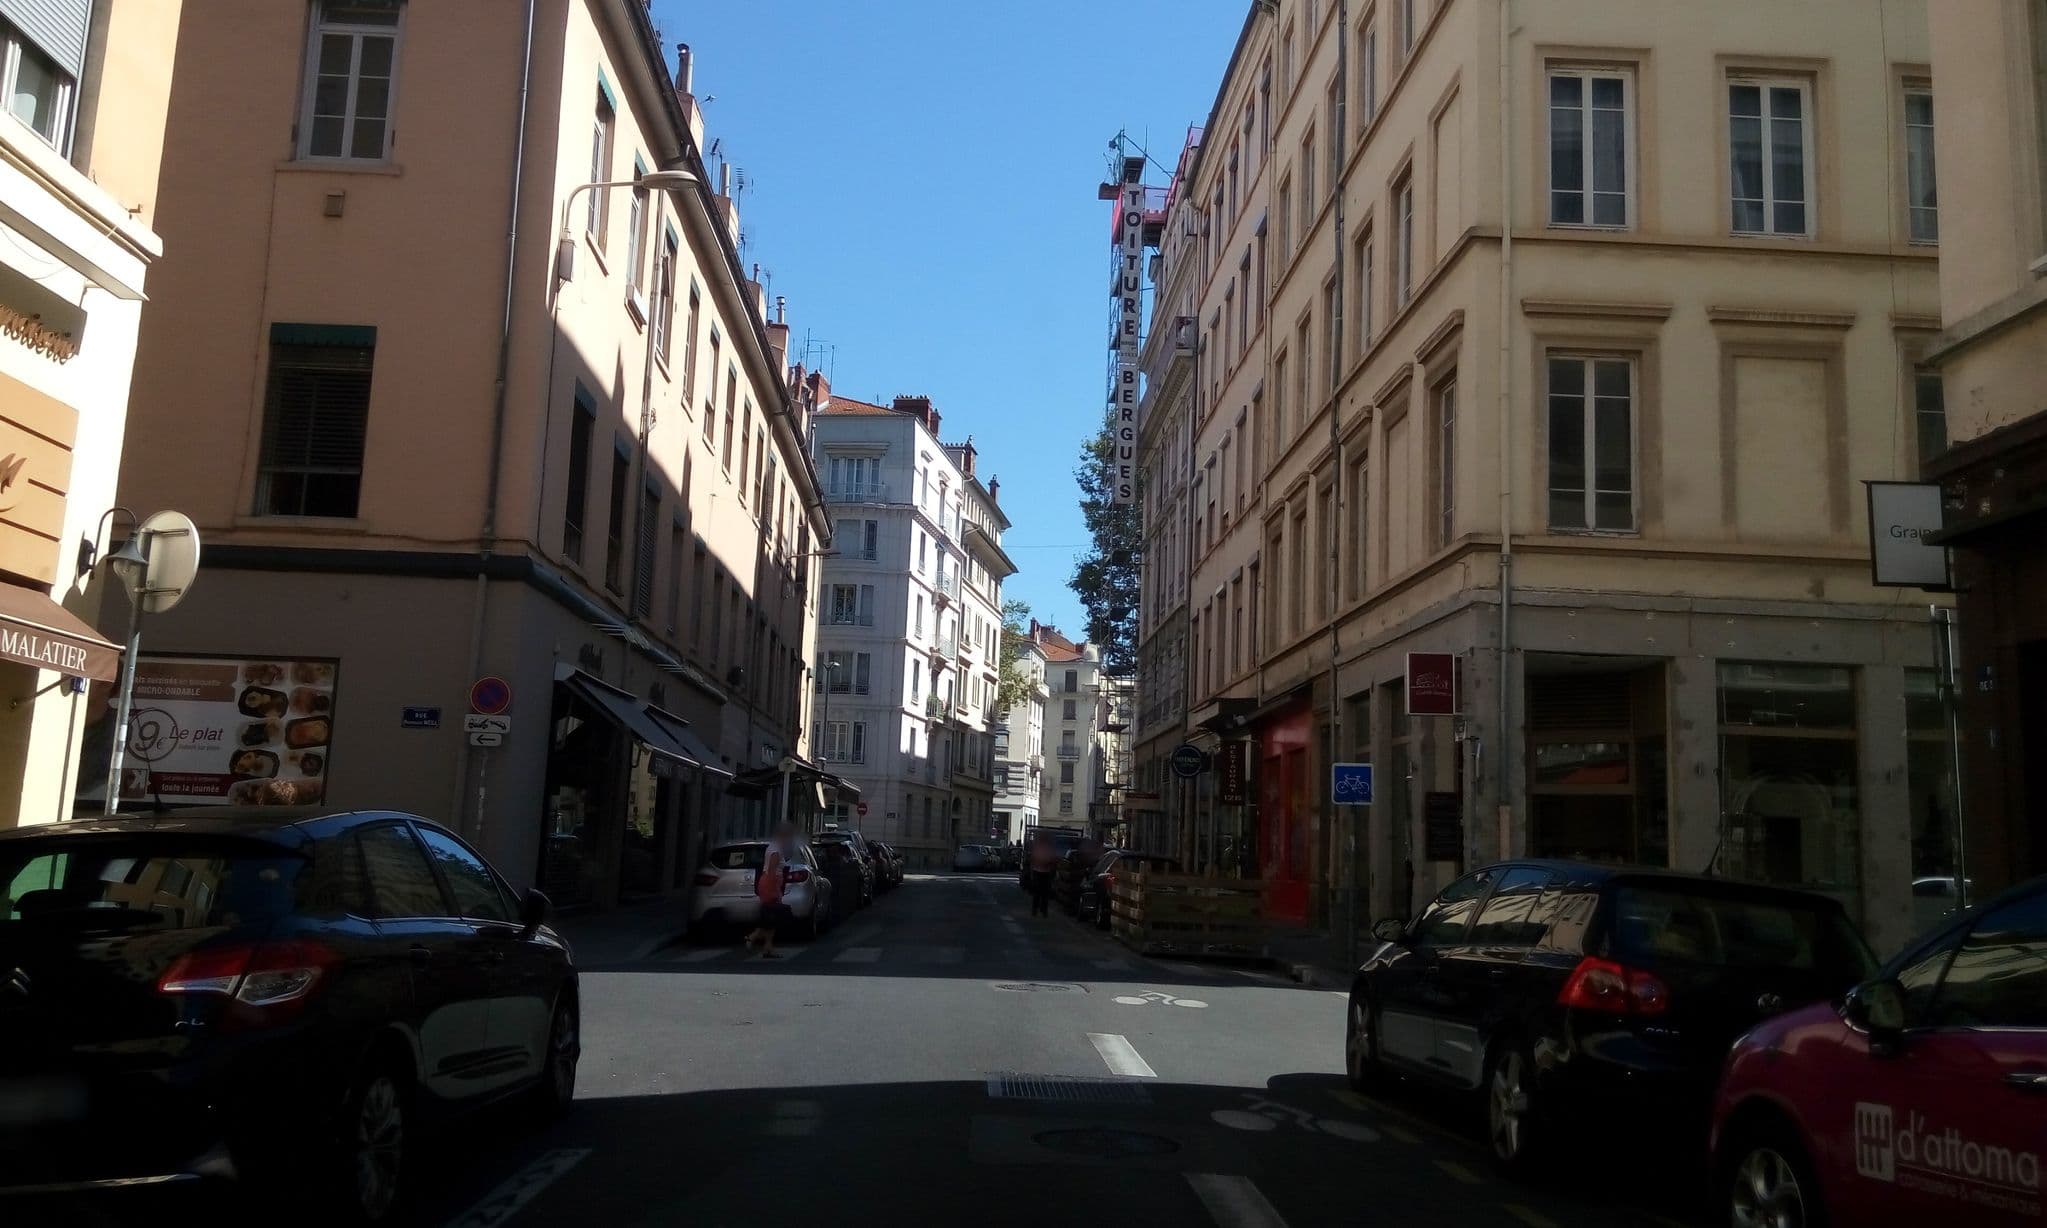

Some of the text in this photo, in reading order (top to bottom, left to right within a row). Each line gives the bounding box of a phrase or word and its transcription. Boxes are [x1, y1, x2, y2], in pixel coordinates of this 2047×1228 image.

[1123, 190, 1142, 336] TOITURE
[1119, 370, 1135, 498] BERGUES
[1890, 524, 1936, 539] Grain
[1, 628, 87, 671] MALATIER
[168, 725, 224, 744] Le plat
[1897, 1108, 2040, 1187] d'attoma
